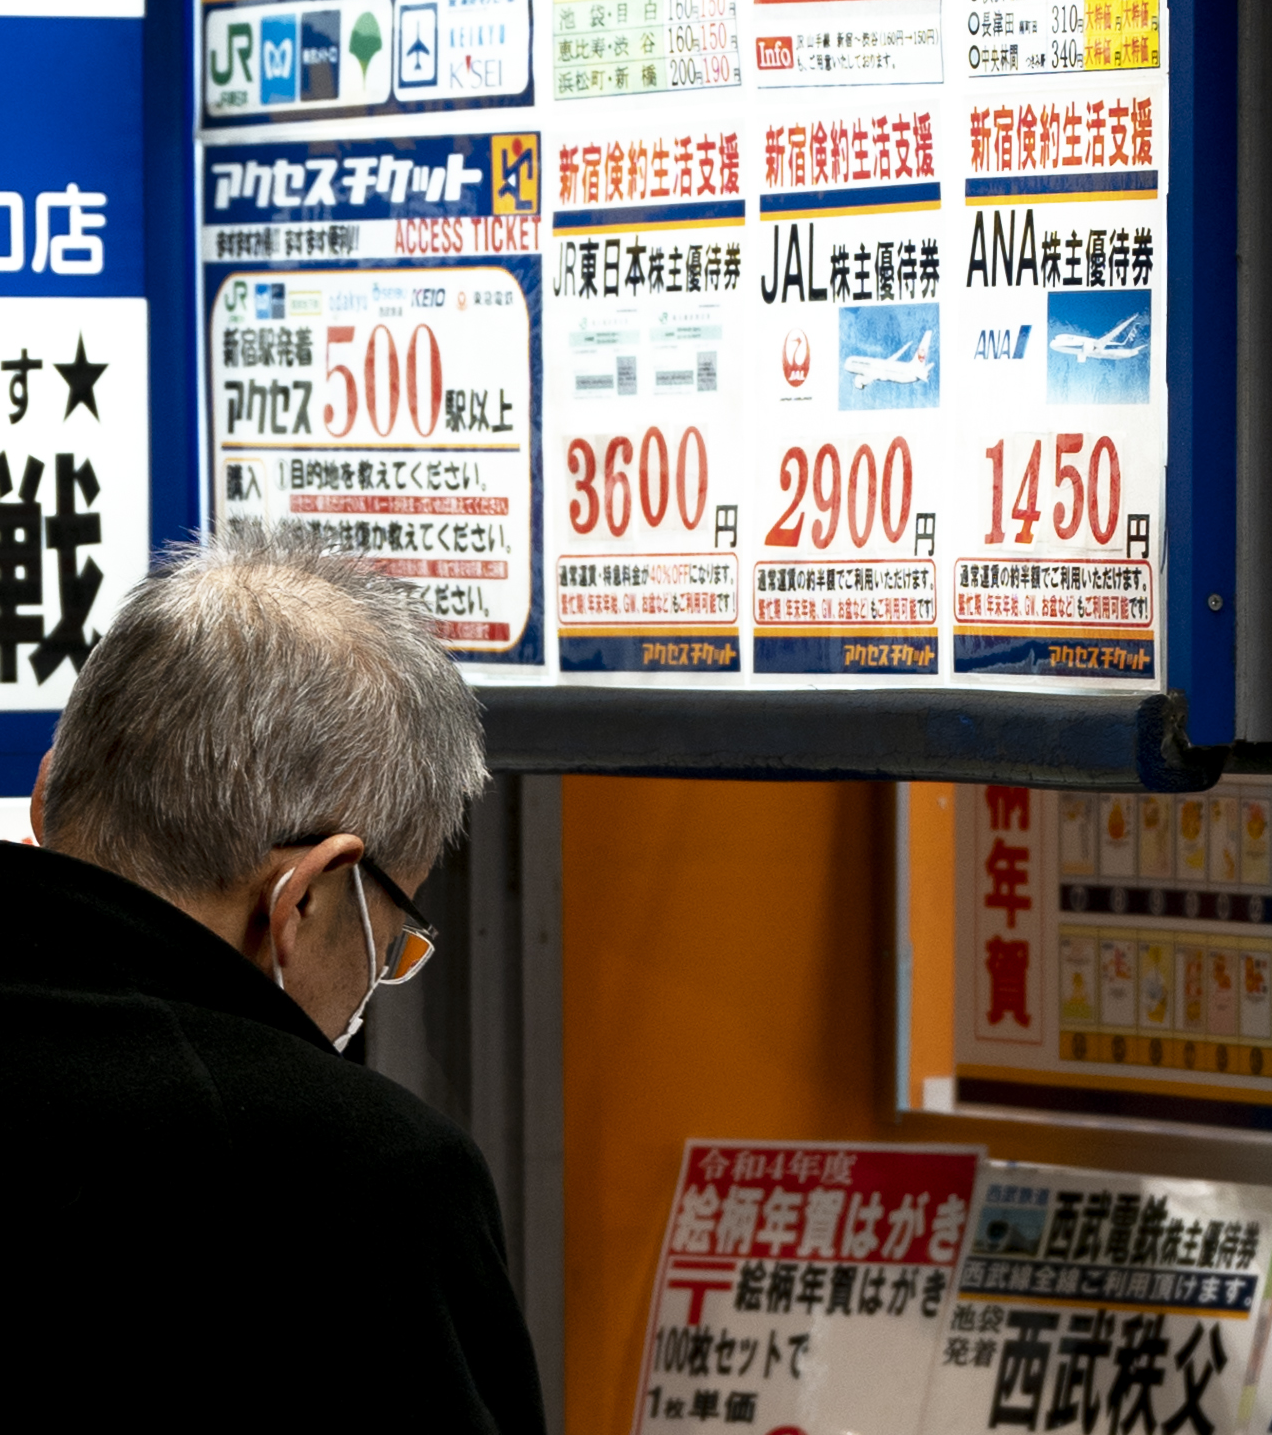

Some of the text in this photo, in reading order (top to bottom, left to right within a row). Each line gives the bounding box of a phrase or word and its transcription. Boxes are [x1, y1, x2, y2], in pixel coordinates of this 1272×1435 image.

[210, 22, 254, 87] JR
[449, 23, 506, 49] KEIKYU
[758, 40, 793, 68] Info
[764, 111, 936, 189] 新宿倹約生活支援
[969, 97, 1155, 175] 新宿倹約生活支援
[211, 152, 483, 211] アクセスチケット
[394, 215, 543, 256] ACCESS TICKET
[552, 233, 742, 299] JR東日本株主優待券
[760, 221, 941, 305] JAL株主優待券
[965, 208, 1155, 291] ANA株主優待券
[224, 327, 314, 368] 新宿駅発着
[973, 329, 1017, 361] ANA
[223, 378, 314, 435] アクセス
[671, 1183, 967, 1266] 絵柄年賀はがき
